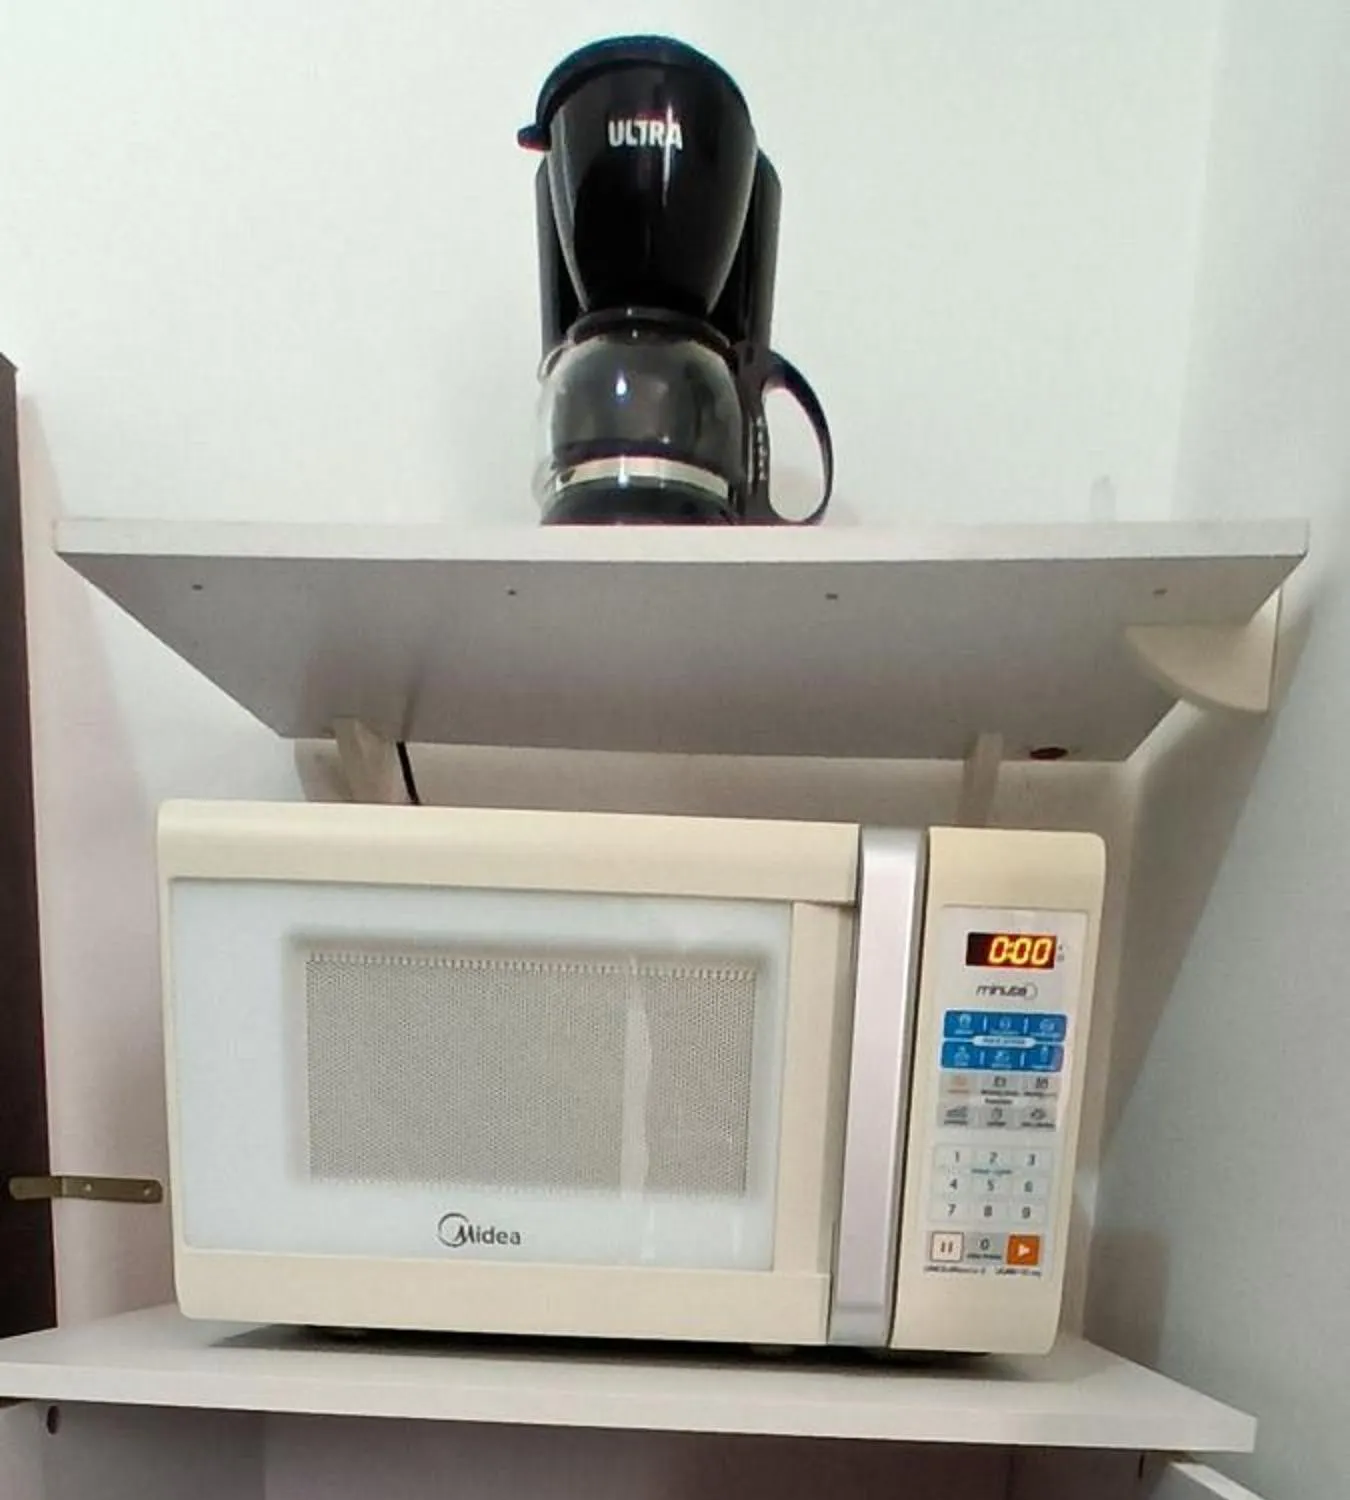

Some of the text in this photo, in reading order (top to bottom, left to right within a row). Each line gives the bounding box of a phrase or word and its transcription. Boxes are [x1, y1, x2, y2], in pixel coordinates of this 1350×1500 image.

[608, 119, 683, 150] ULTRA
[988, 935, 1053, 966] 0:00
[438, 1213, 522, 1248] Midea
[980, 1238, 990, 1250] 0
